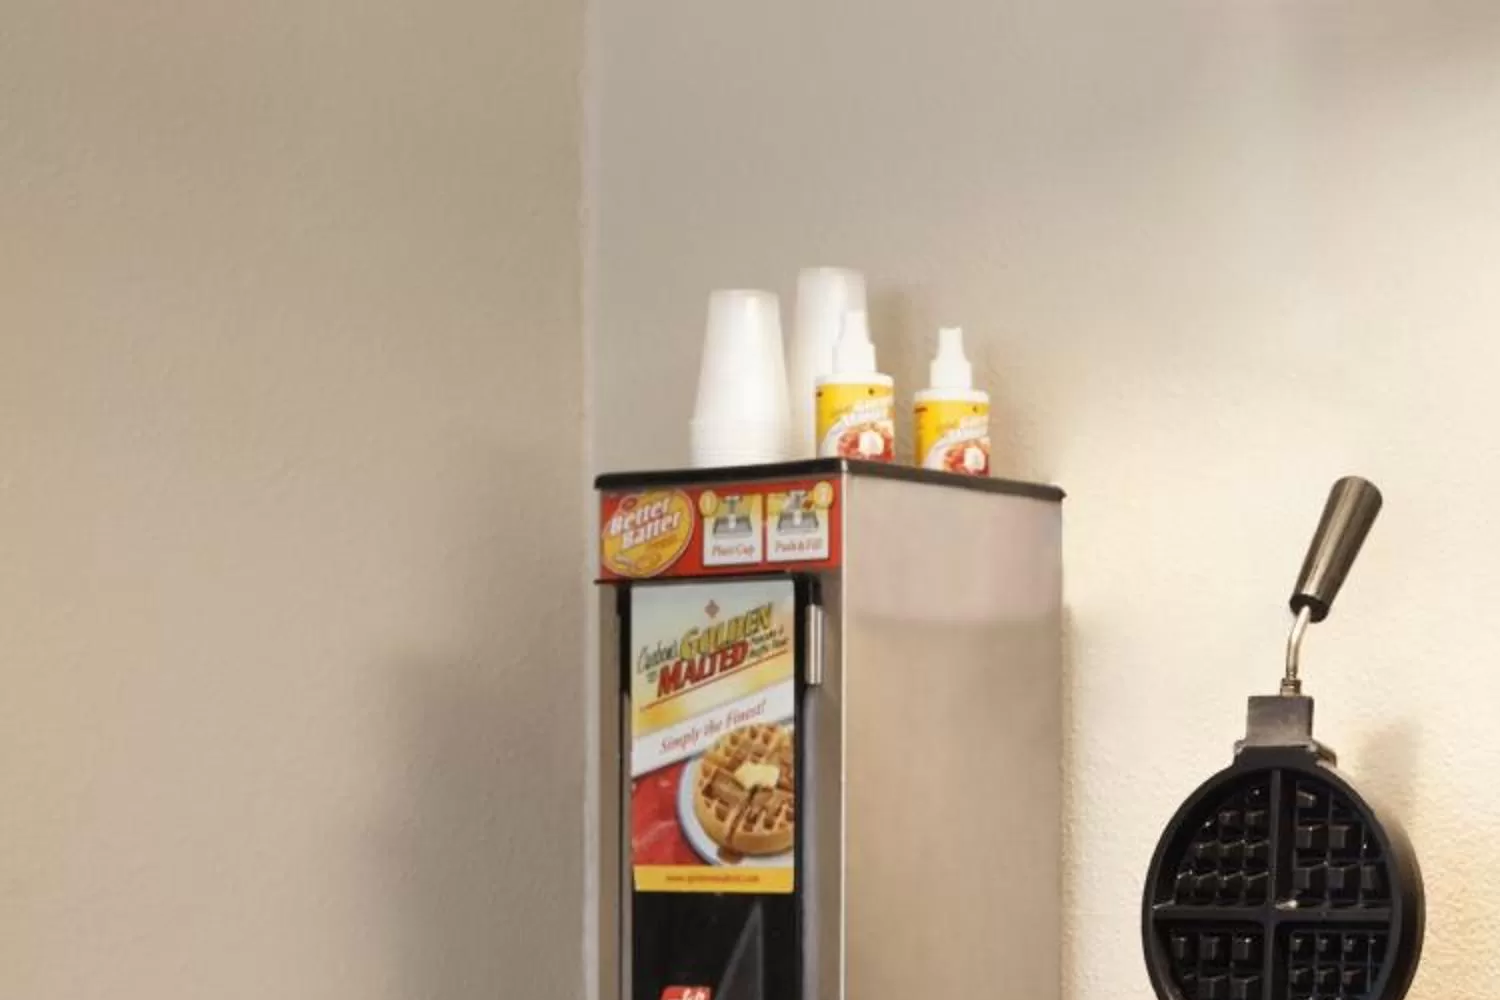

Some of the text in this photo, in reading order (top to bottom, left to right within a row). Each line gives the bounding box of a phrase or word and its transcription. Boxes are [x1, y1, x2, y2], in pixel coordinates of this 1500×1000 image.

[610, 497, 670, 536] Better
[623, 512, 680, 549] Batter
[680, 602, 773, 661] GOLDEN
[656, 640, 750, 697] MALTED
[703, 718, 722, 737] the
